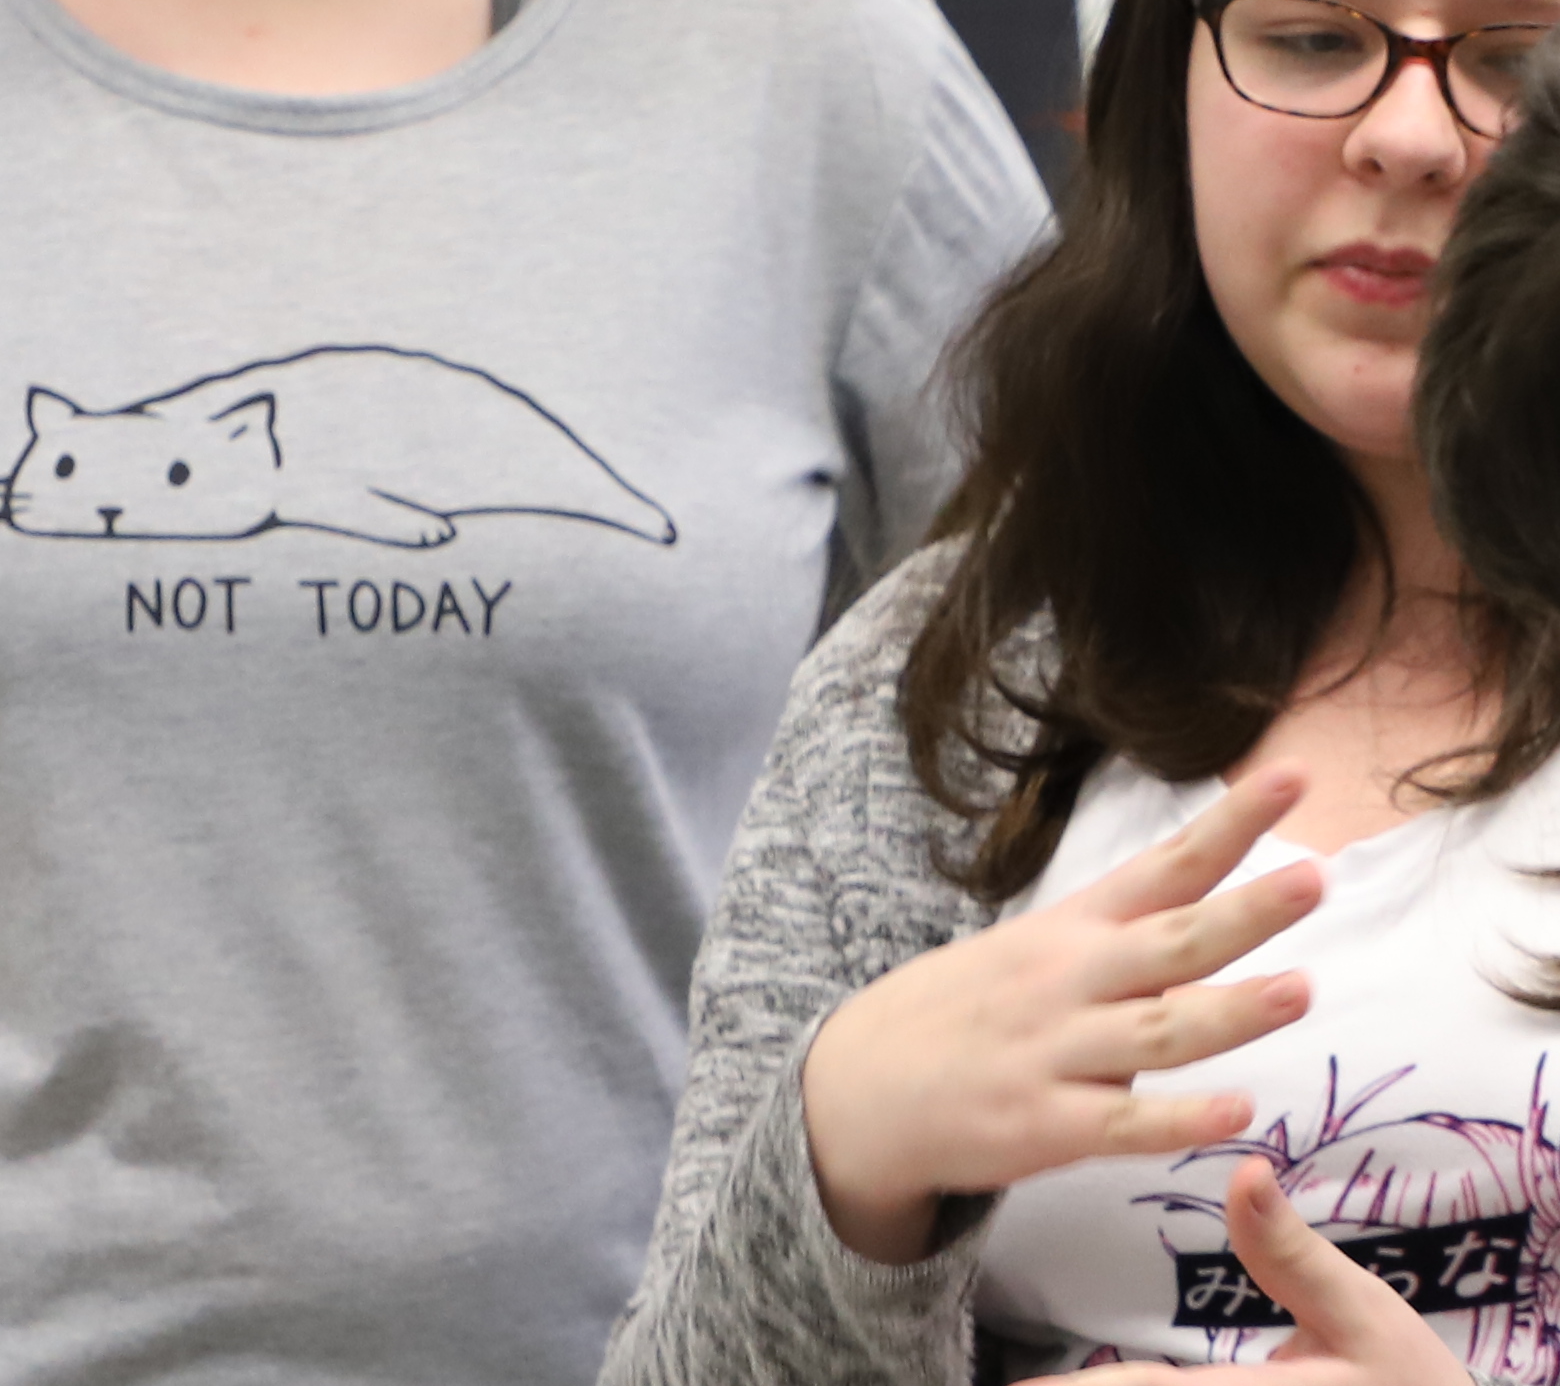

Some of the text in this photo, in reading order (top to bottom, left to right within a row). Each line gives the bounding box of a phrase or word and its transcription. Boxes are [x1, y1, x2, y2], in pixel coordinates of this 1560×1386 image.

[126, 576, 513, 636] NOT TODAY
[1183, 1230, 1520, 1317] みらな
